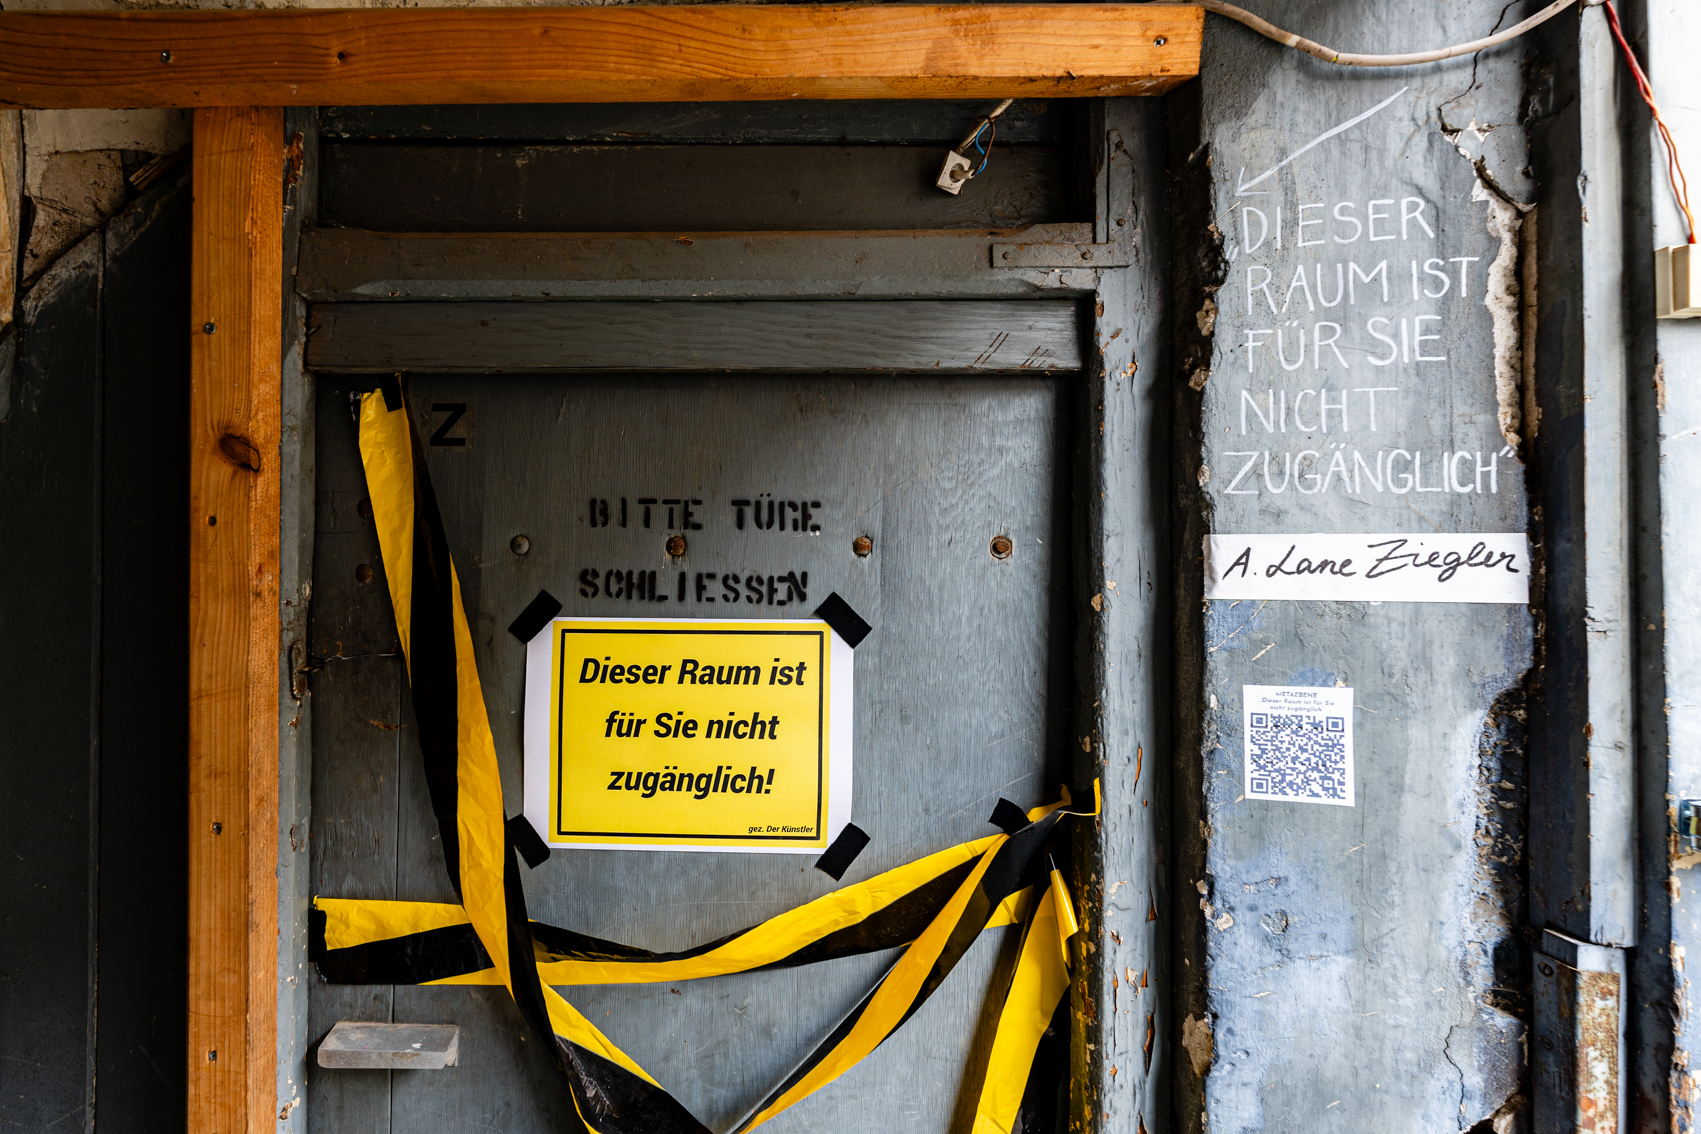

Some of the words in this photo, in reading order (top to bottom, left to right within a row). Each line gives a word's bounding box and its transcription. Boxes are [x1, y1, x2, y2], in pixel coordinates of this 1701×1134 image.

[1246, 259, 1389, 315] RAUM
[1411, 256, 1480, 300] IST
[1243, 320, 1349, 373] FÜR
[1366, 314, 1447, 366] SIE
[1239, 387, 1399, 435] NICHT
[589, 497, 703, 530] BITTE
[731, 492, 821, 532] TÜRE
[1222, 546, 1257, 580] A.
[1265, 544, 1357, 578] Lane
[1365, 538, 1520, 583] Ziegler
[579, 568, 808, 606] SCHLIESSEN
[579, 656, 671, 685] Dieser
[677, 658, 761, 686] Raum
[769, 658, 807, 686] ist
[604, 710, 647, 738] für
[653, 711, 698, 739] Sie
[705, 711, 780, 740] nicht
[607, 765, 775, 800] zugänglich!
[748, 826, 764, 834] gez.
[766, 825, 780, 833] Der
[781, 825, 814, 833] Künstler
